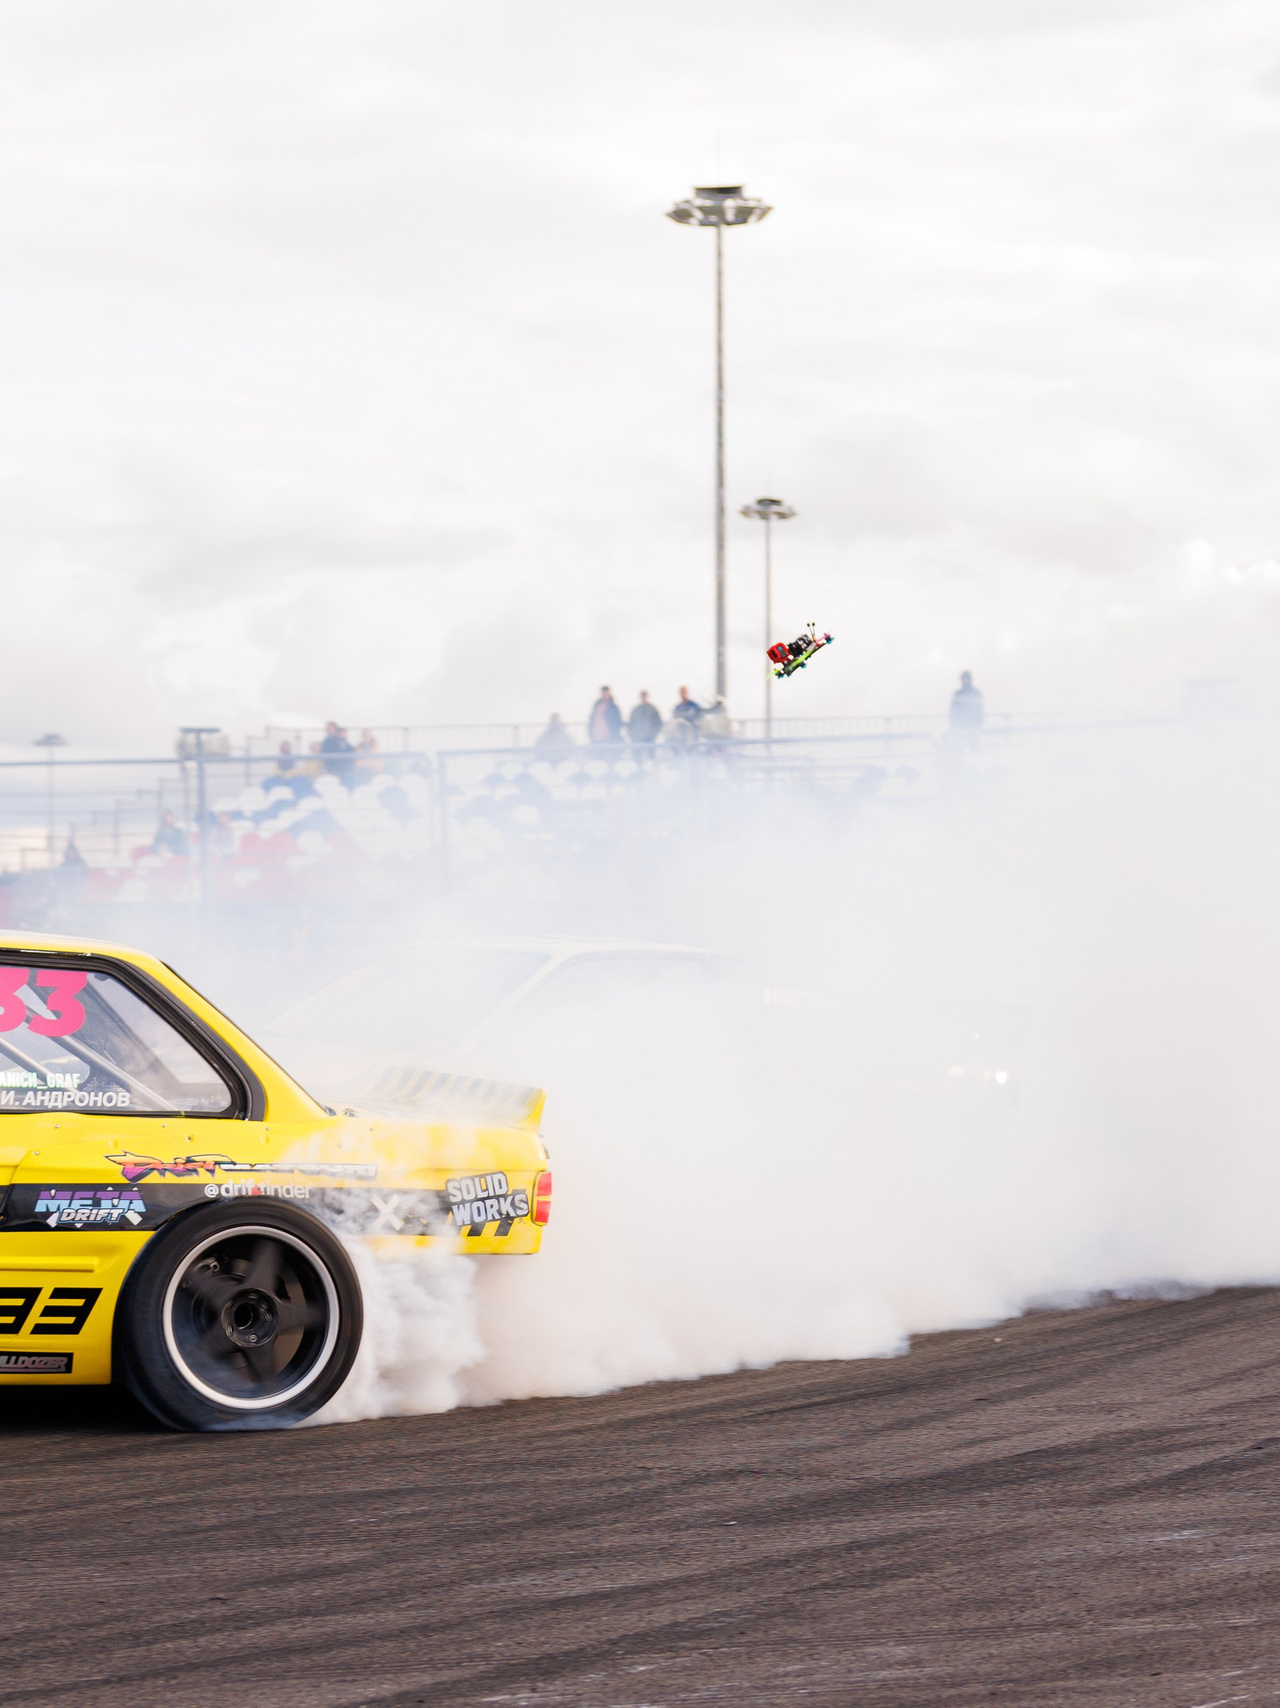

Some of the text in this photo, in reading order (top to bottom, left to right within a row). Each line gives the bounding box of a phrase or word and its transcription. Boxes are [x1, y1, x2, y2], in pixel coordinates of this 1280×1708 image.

[0, 1091, 131, 1109] И. АНДРОНОВ
[447, 1173, 507, 1202] SOLID
[34, 1190, 146, 1213] META
[452, 1194, 529, 1225] WORKS
[59, 1207, 125, 1222] DRIFT
